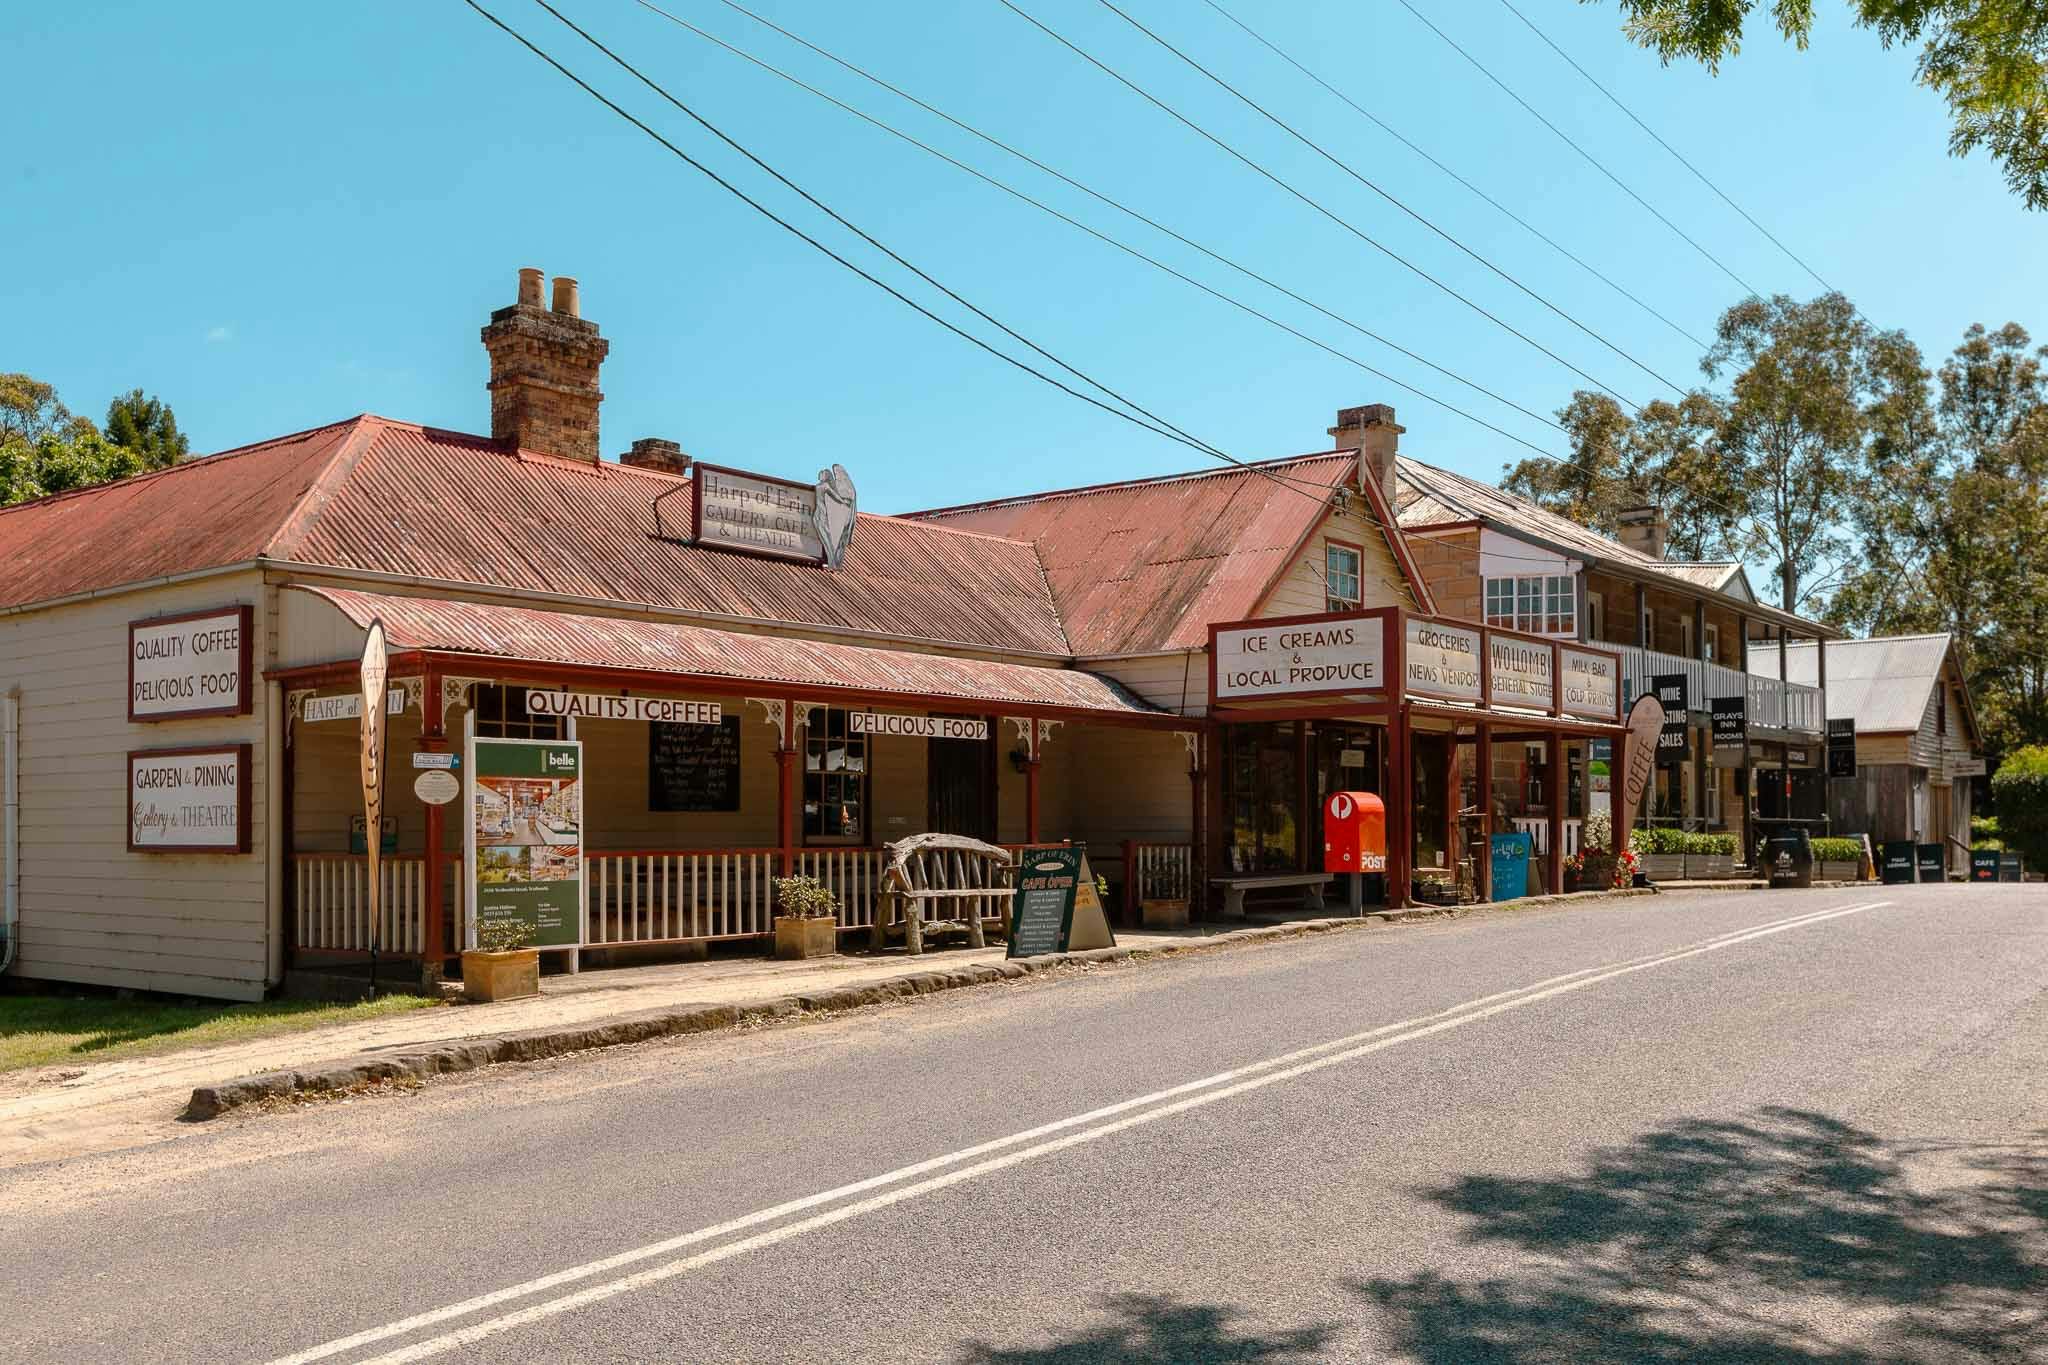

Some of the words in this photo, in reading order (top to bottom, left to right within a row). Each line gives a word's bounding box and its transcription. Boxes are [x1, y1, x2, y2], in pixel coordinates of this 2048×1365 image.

[703, 474, 750, 507] Harp
[755, 484, 774, 506] of
[776, 488, 812, 516] Erin
[719, 523, 730, 537] &
[735, 524, 798, 548] THEATRE
[135, 634, 186, 660] QUALITY
[191, 628, 239, 656] COFFEE
[1242, 635, 1268, 654] ICE
[1279, 628, 1355, 651] CREAMS
[1418, 630, 1471, 654] GROCERIES
[1292, 652, 1303, 665] &
[1492, 643, 1551, 678] WOLLOMBI
[1571, 658, 1589, 673] MILK
[1591, 662, 1608, 678] BAR
[135, 675, 194, 702] DELICIOUS
[200, 672, 238, 696] FOOD
[1227, 669, 1282, 689] LOCAL
[1289, 662, 1374, 684] PRODUCE
[1408, 663, 1438, 683] NEWS
[1440, 667, 1480, 688] VENDOR
[1491, 674, 1529, 696] GENERAL
[1529, 682, 1552, 699] STORE
[1566, 687, 1586, 704] COLD
[1587, 690, 1613, 708] DRINKS
[1659, 687, 1681, 701] WINE
[305, 698, 345, 720] HARP
[1664, 709, 1687, 725] STING
[1713, 711, 1744, 721] GRAYS
[852, 713, 936, 737] DELICIOUS
[943, 720, 986, 739] FOOD
[1720, 720, 1737, 729] INN
[1659, 733, 1684, 748] SALES
[550, 753, 575, 766] belle
[136, 767, 182, 789] GARDEN
[194, 764, 235, 787] DINING
[1624, 738, 1653, 806] COFFEE
[133, 801, 169, 843] Gallery
[181, 804, 237, 827] THEATRE
[1361, 855, 1386, 869] POST
[1974, 859, 1995, 867] CAFE
